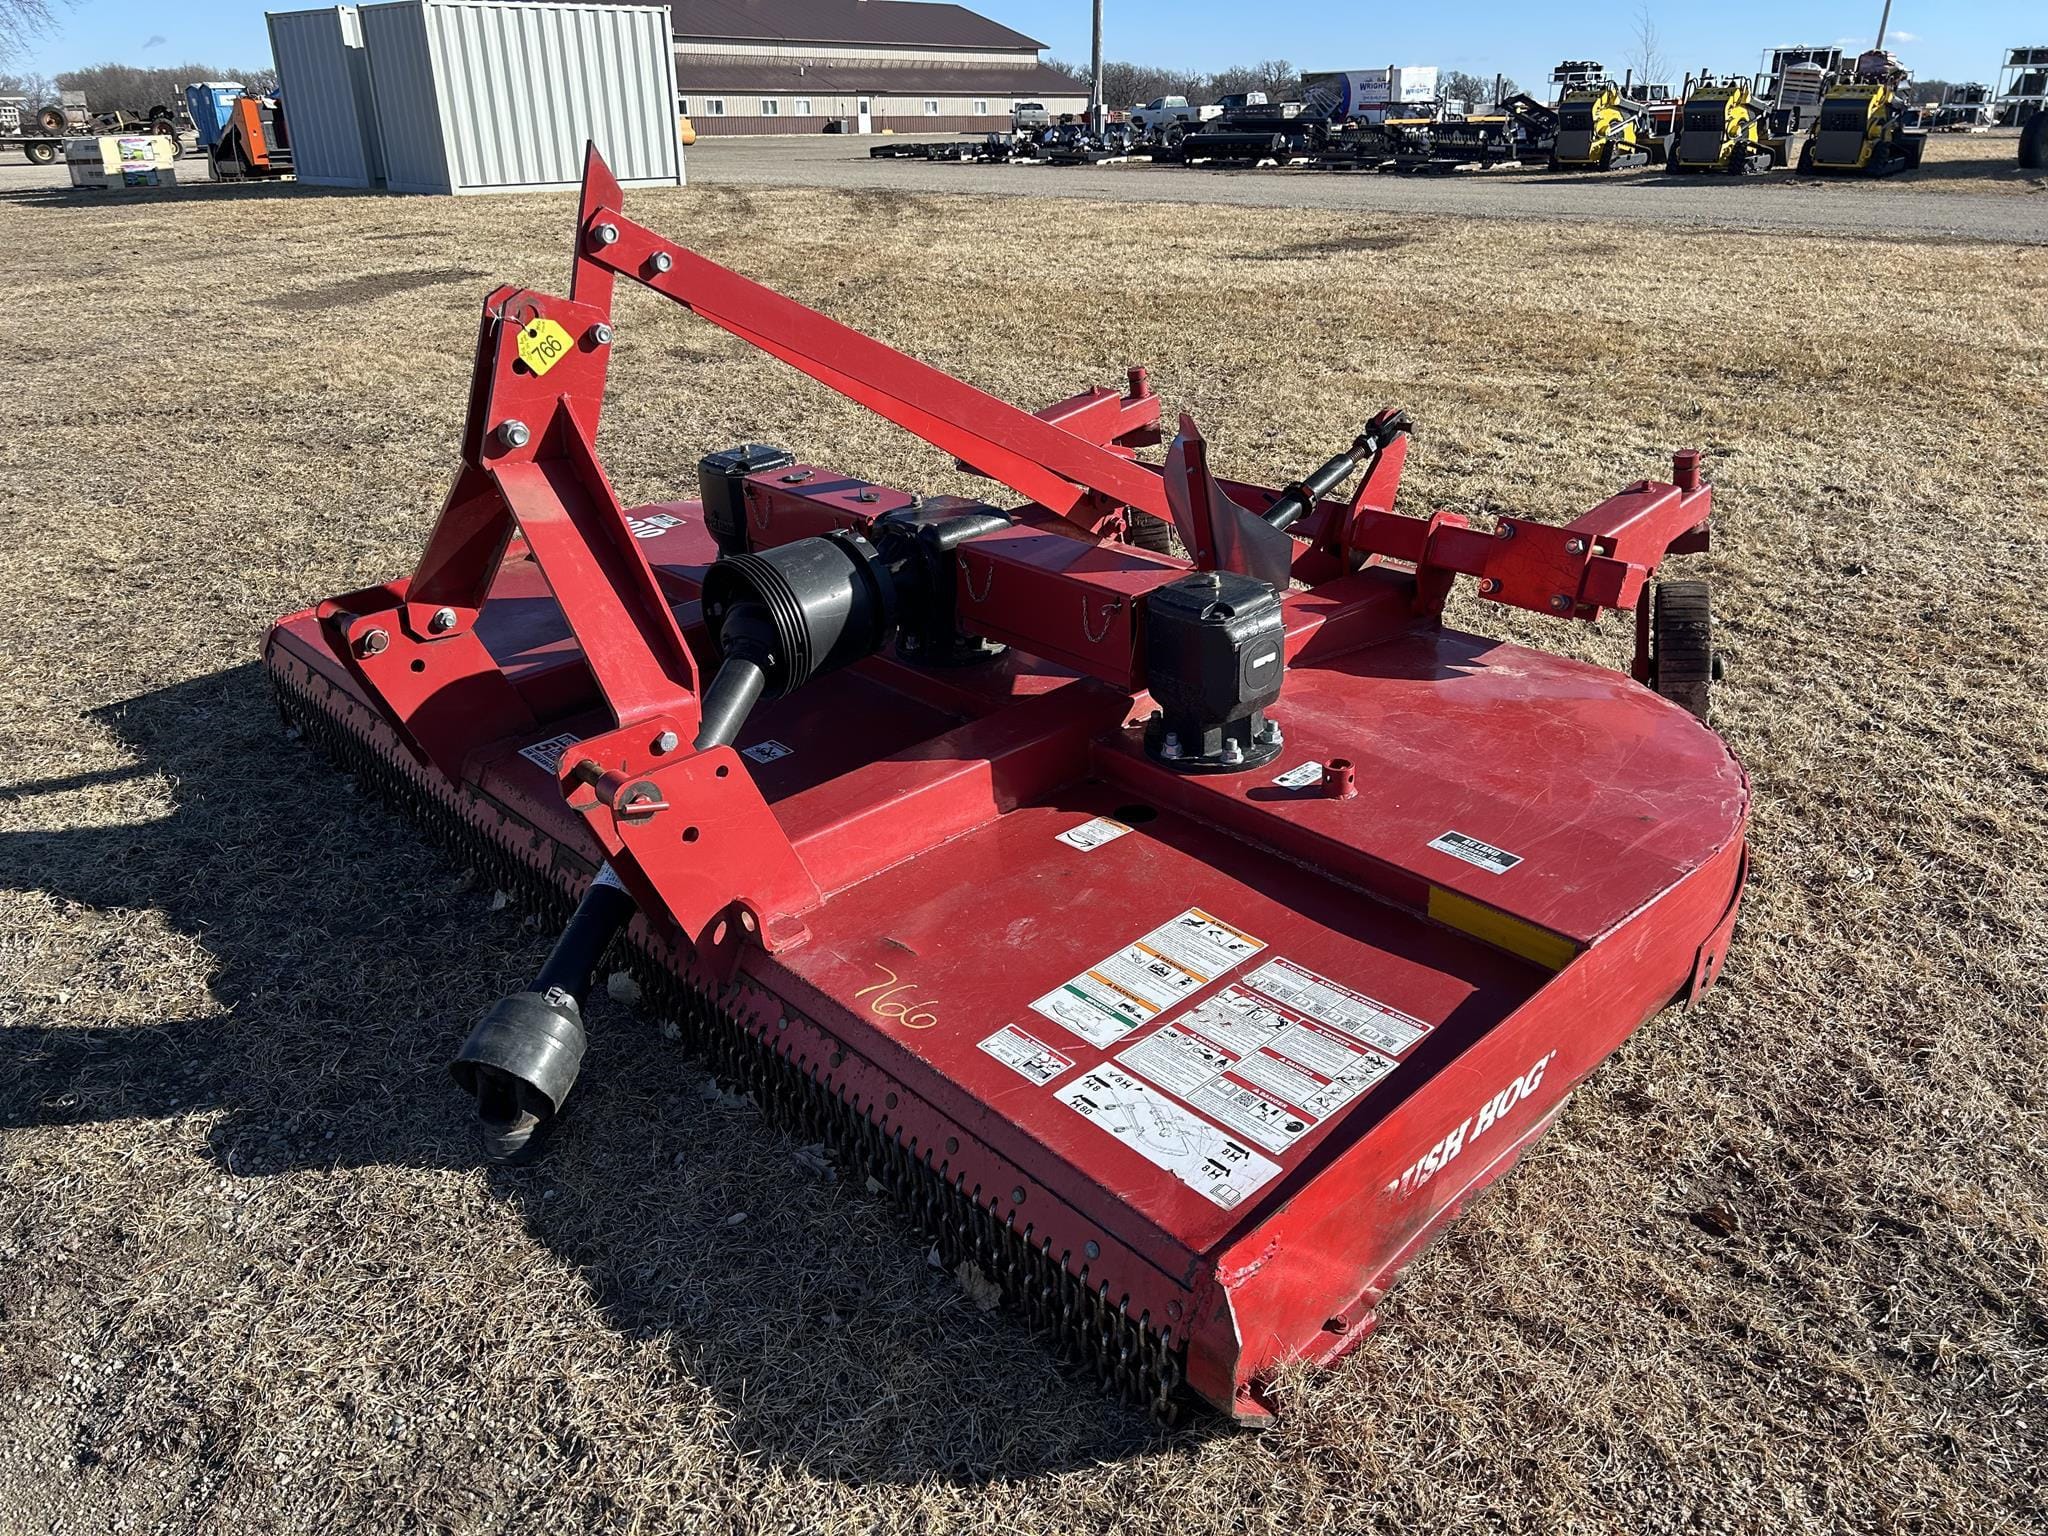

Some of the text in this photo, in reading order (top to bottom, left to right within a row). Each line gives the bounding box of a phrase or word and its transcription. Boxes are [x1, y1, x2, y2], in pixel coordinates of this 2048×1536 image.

[531, 335, 562, 366] 766
[1474, 844, 1501, 857] LAND
[1215, 921, 1242, 938] WARNING
[1286, 964, 1314, 980] PELIGRO
[855, 963, 939, 1029] 766
[1324, 981, 1352, 997] DANGER
[1084, 996, 1116, 1015] IMPORTANT
[1356, 997, 1384, 1012] PERIGO
[1394, 1013, 1423, 1029] GEFAHR
[1196, 1036, 1223, 1052] DANGER
[1321, 1032, 1351, 1047] DANGER
[1285, 1060, 1314, 1077] DANGER
[1259, 1092, 1288, 1109] DANGER
[1469, 1053, 1550, 1144] HOG
